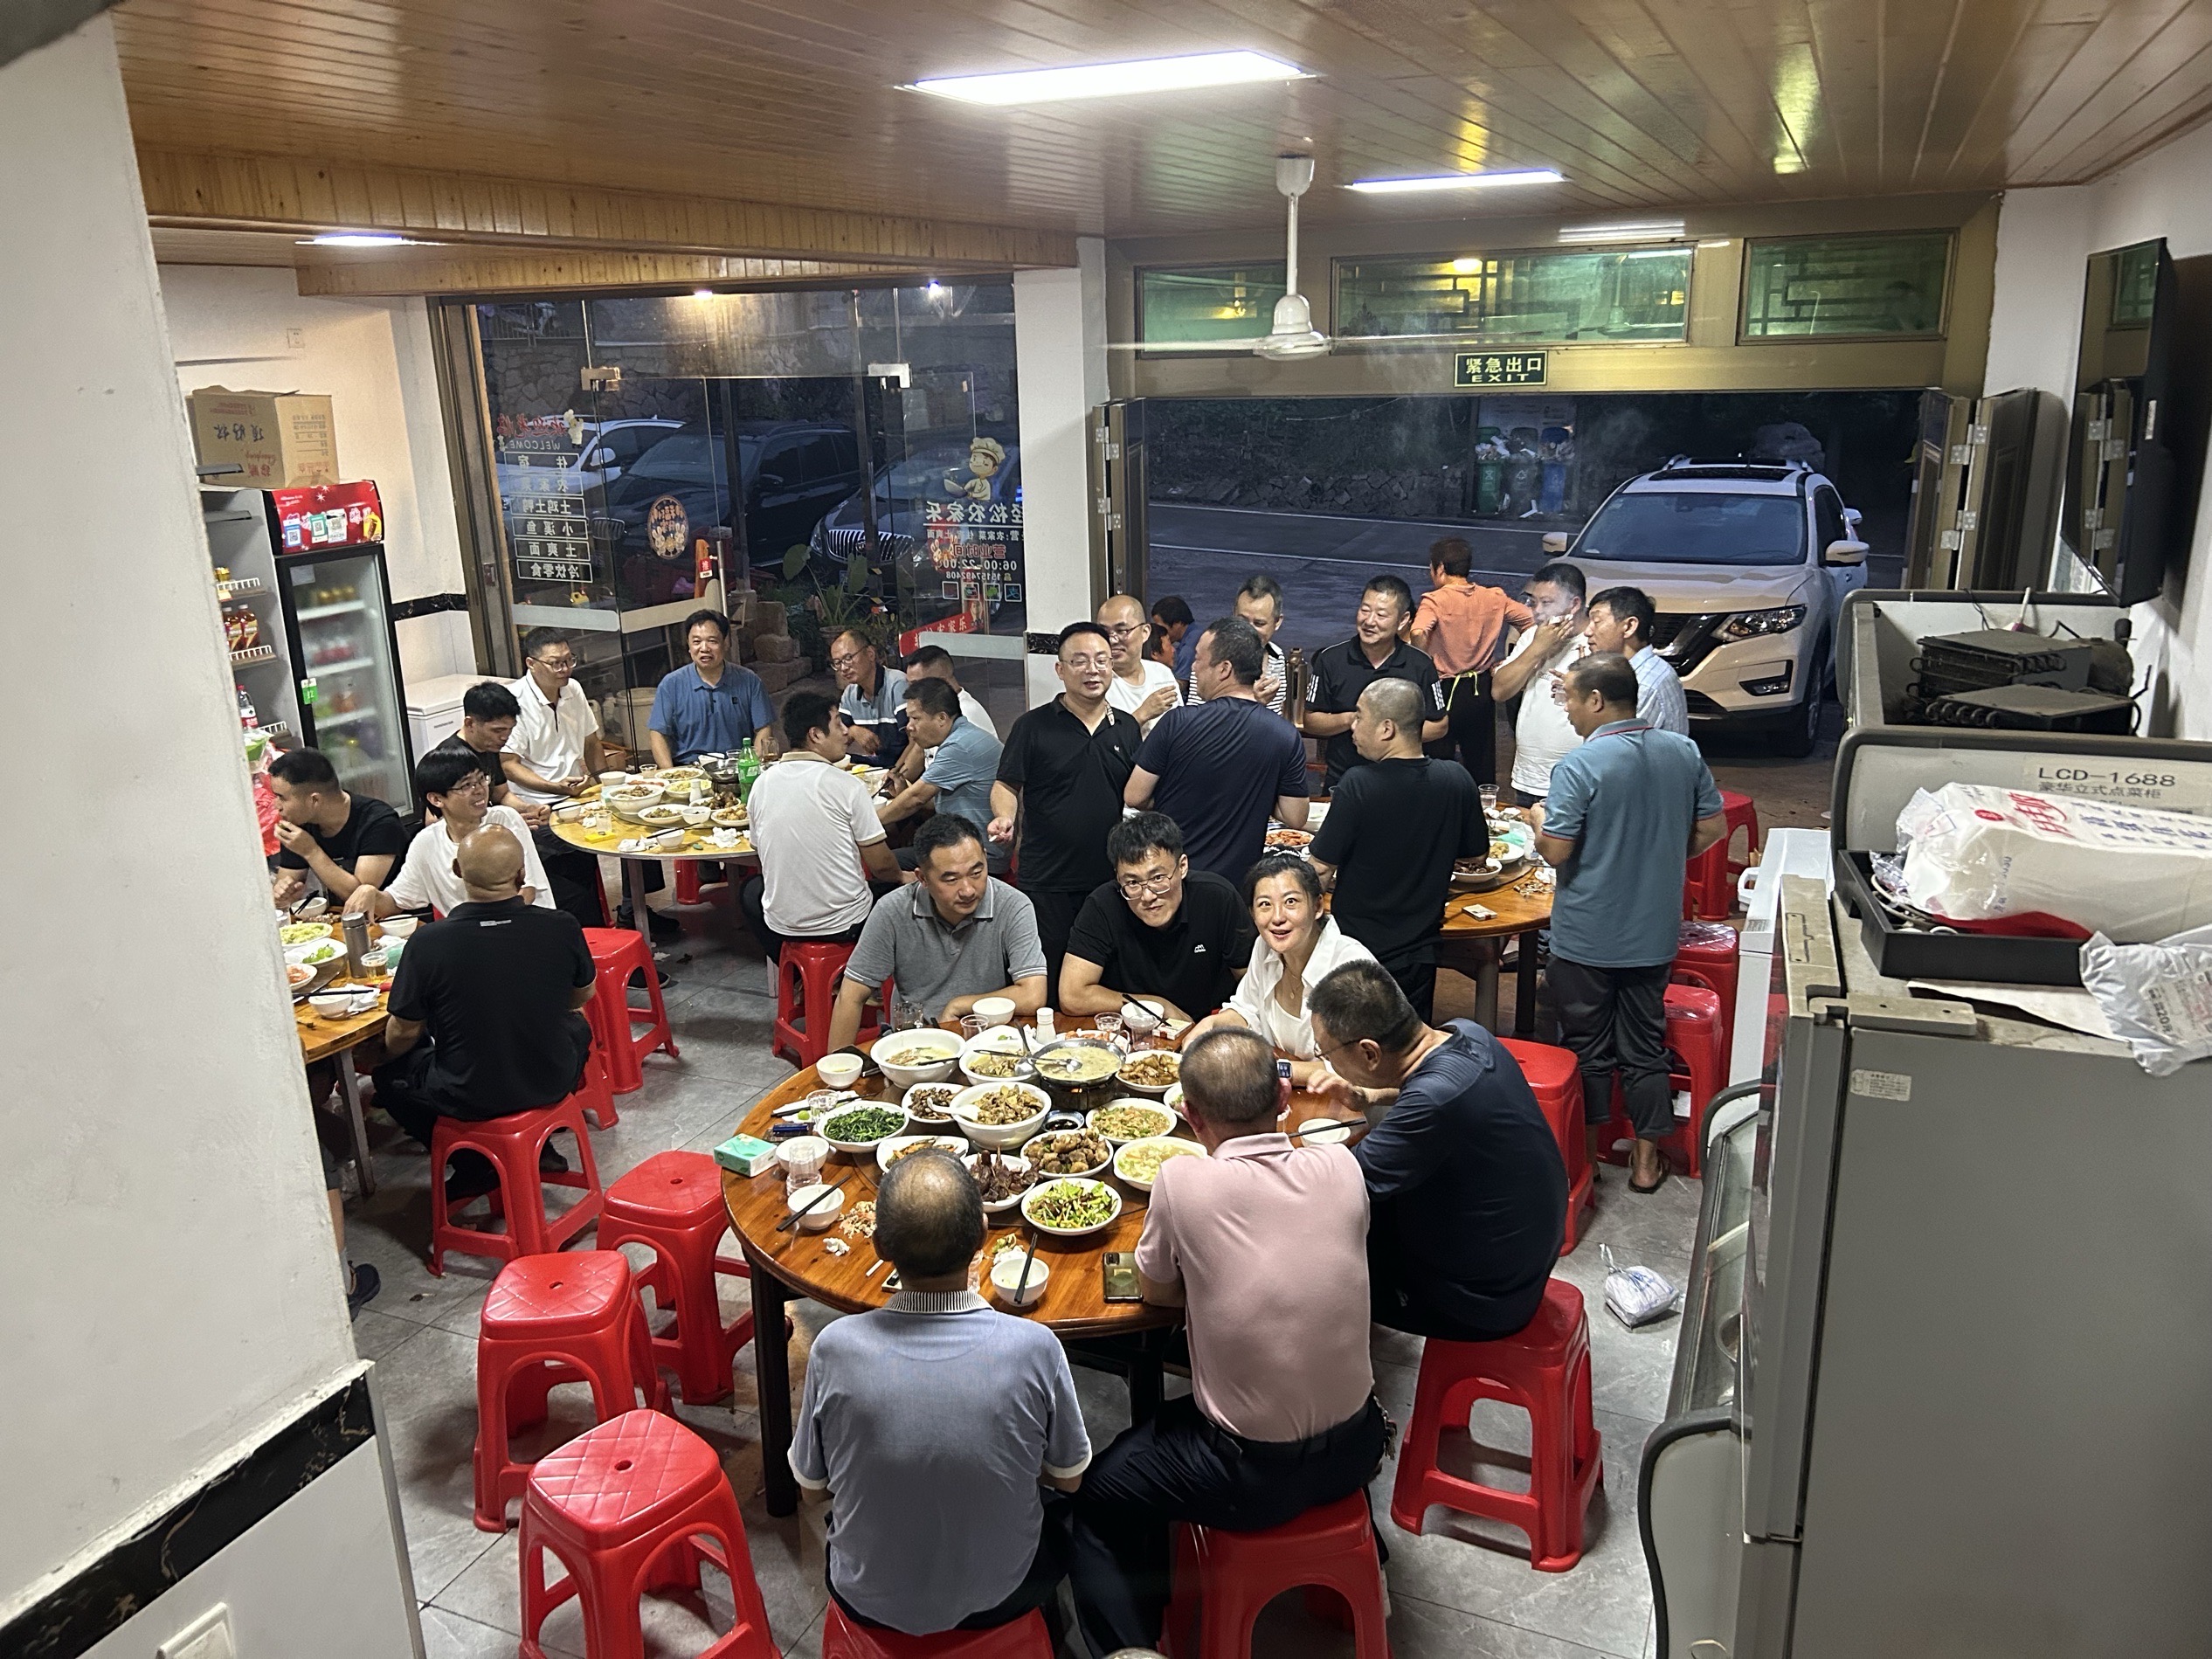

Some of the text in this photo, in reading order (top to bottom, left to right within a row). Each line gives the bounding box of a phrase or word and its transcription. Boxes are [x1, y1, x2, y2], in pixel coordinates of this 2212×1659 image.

[1466, 356, 1542, 374] 紧急出口
[1471, 373, 1530, 383] EXIT
[2039, 767, 2175, 787] LCD-1688
[2038, 782, 2162, 799] 豪华立式点菜柜
